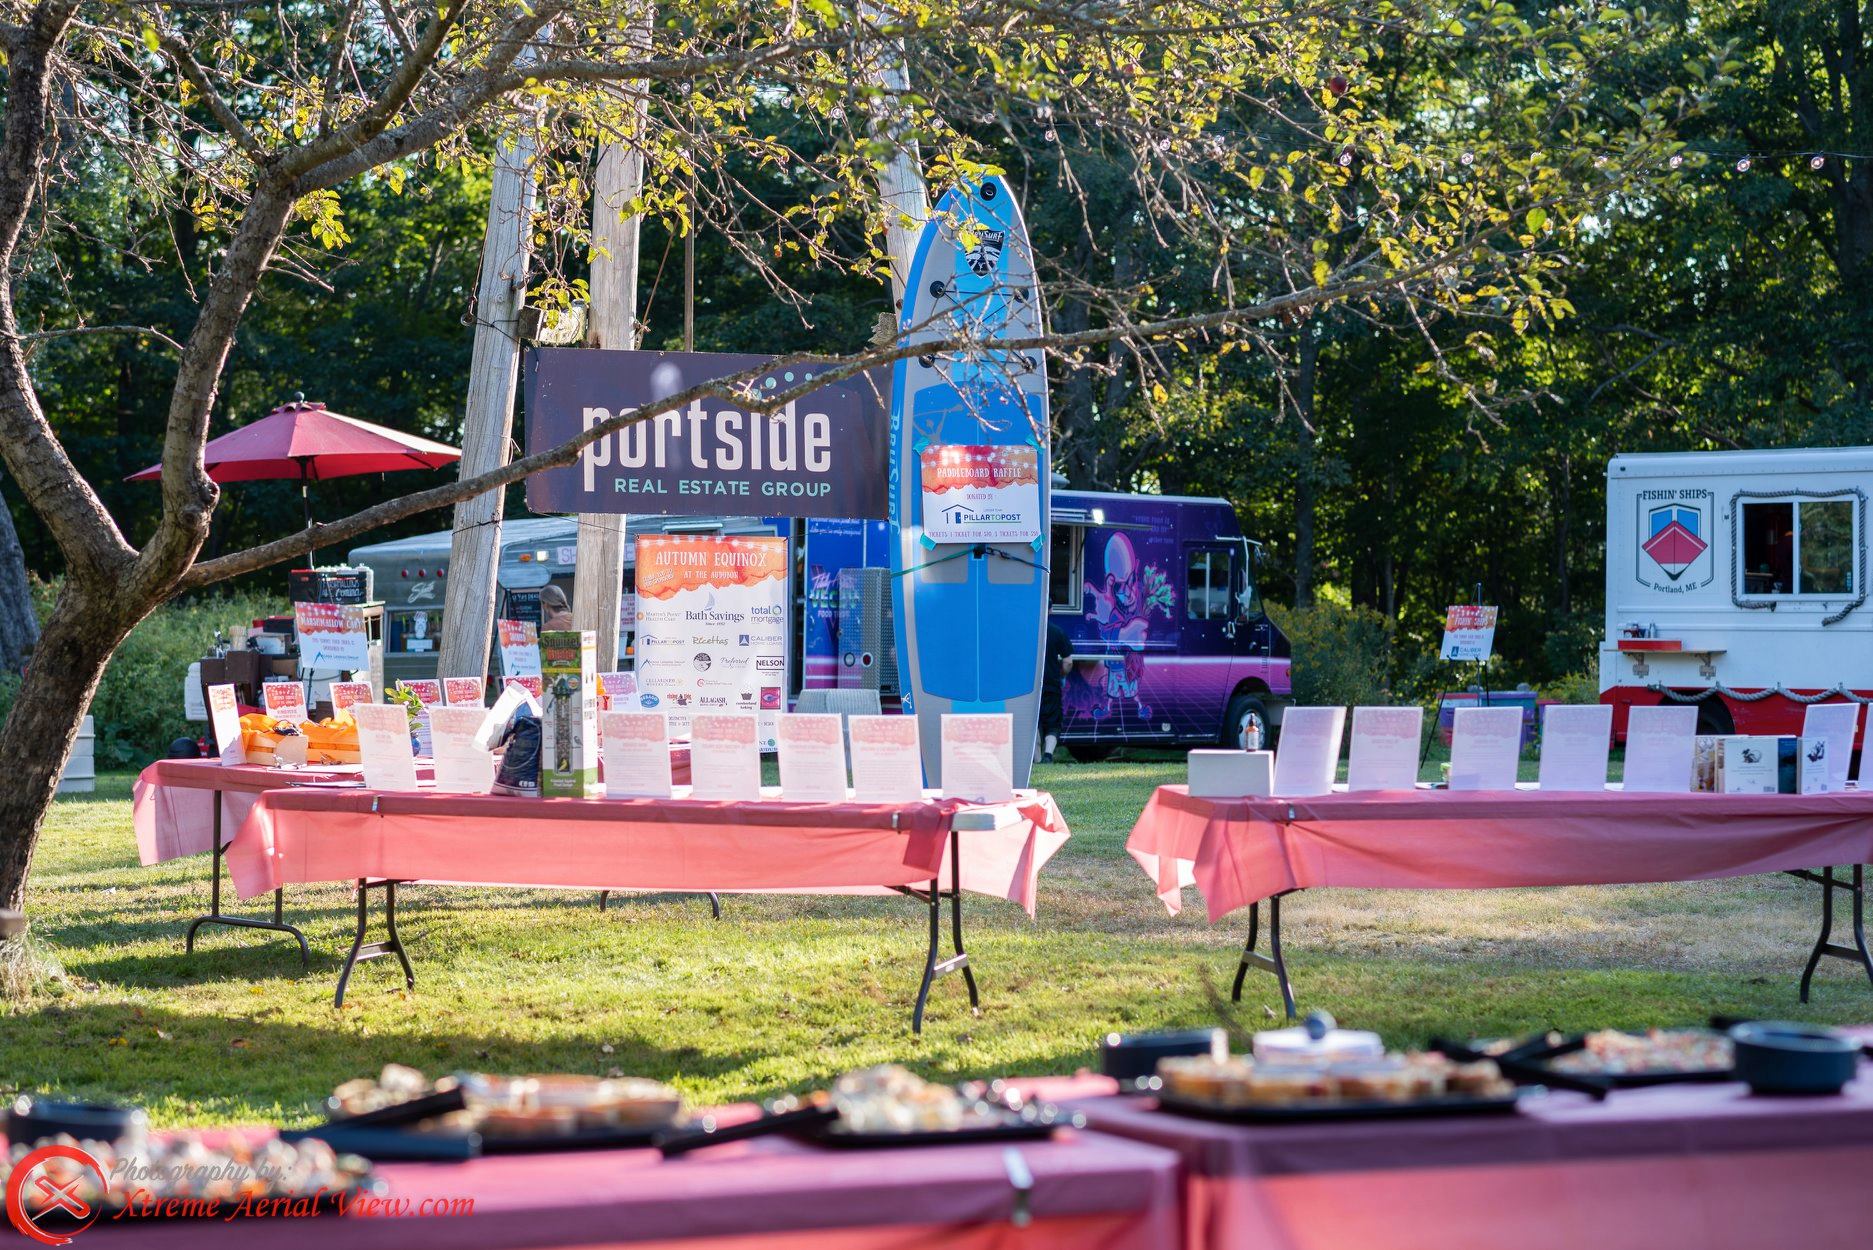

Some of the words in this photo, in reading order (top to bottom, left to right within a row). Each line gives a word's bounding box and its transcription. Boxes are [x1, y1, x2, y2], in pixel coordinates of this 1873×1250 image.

[582, 397, 831, 492] portside
[937, 468, 990, 478] PADDLEBOARD
[993, 468, 1022, 478] RAFFLE
[614, 478, 668, 494] REAL
[678, 479, 751, 496] ESTATE
[761, 481, 832, 497] GROUP
[1642, 489, 1677, 500] FISHIN'
[1679, 489, 1708, 499] SHIPS
[963, 513, 1021, 521] PILLARTOPOST
[656, 551, 707, 566] AUTUMN
[714, 552, 767, 567] EQUINOX
[683, 570, 692, 579] AT
[696, 570, 708, 579] THE
[711, 571, 739, 579] AUDUBON
[1653, 582, 1685, 594] Portland,
[1686, 582, 1698, 591] ME
[751, 605, 771, 615] total
[685, 611, 708, 621] Bath
[709, 611, 745, 624] Savings
[750, 616, 784, 625] mortgage
[757, 659, 784, 667] NELSON
